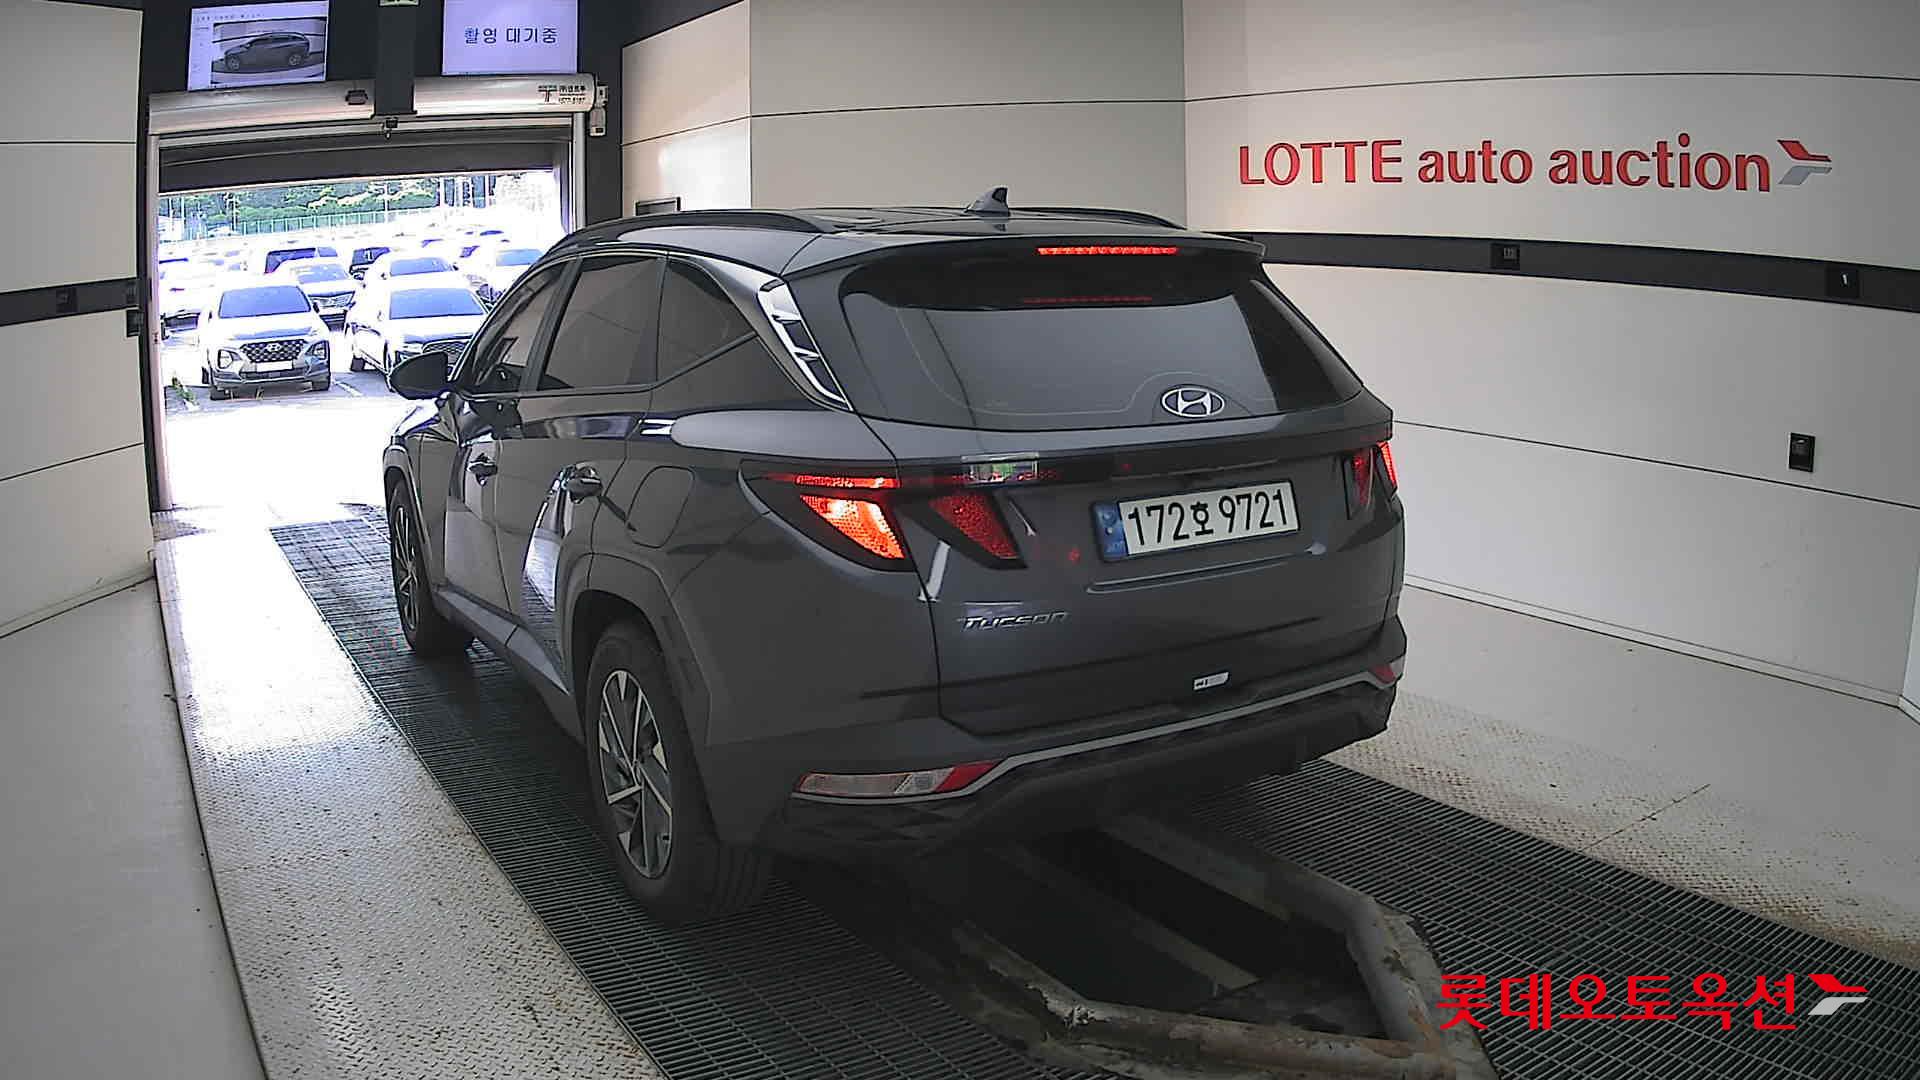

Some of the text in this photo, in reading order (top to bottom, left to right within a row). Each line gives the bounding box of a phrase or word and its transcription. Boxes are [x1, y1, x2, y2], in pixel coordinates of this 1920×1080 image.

[465, 27, 557, 43] 촬영 대기중
[1239, 133, 1772, 193] LOTTE auto auction
[1128, 488, 1288, 545] 172호 9721
